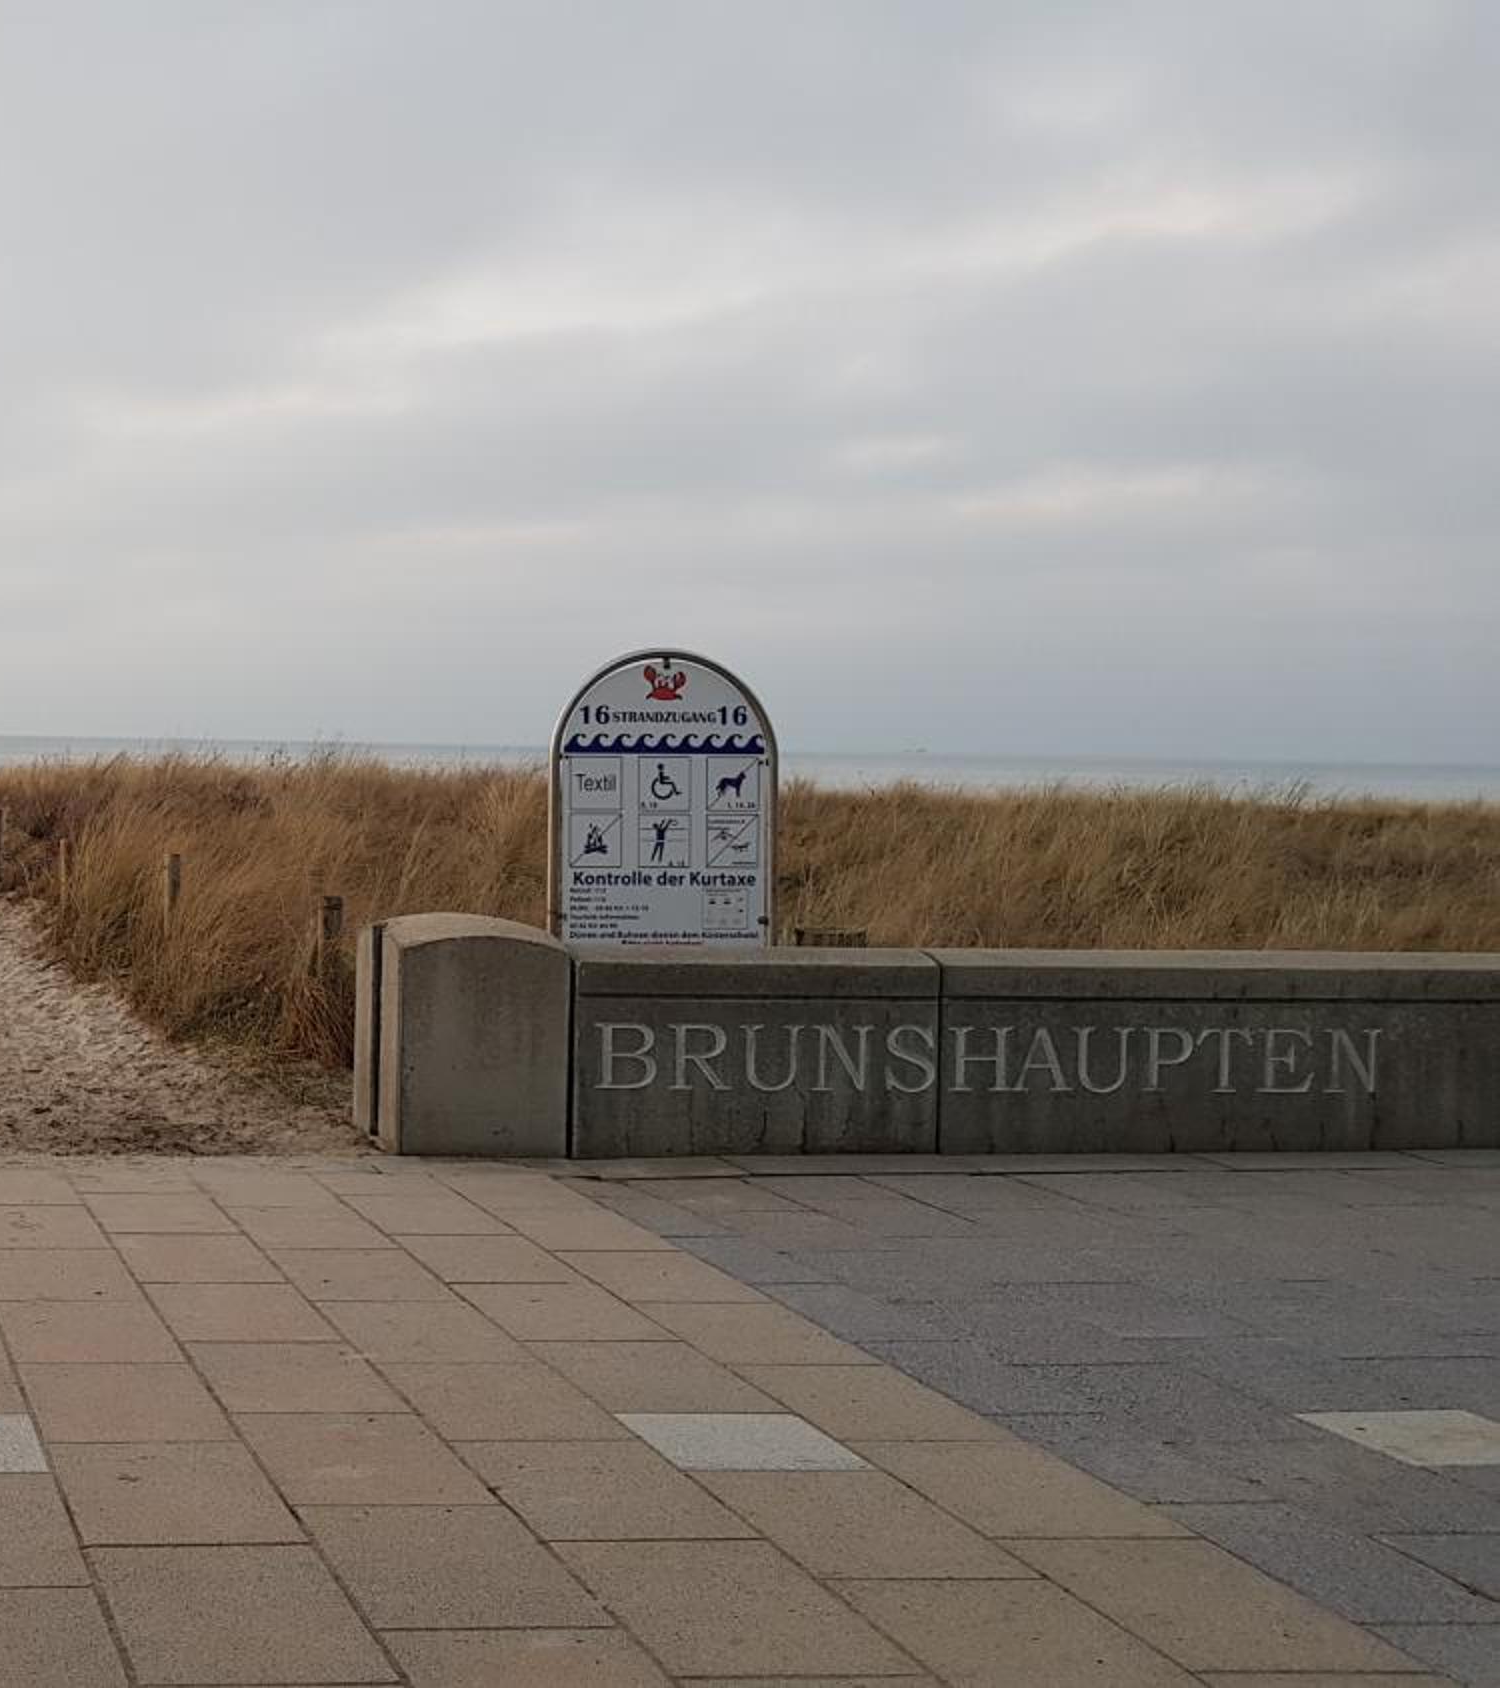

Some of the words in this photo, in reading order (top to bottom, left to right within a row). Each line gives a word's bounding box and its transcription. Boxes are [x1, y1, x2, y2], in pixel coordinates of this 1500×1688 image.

[580, 705, 611, 725] 16
[612, 711, 717, 724] STRANDZUGANG
[717, 705, 748, 726] 16
[575, 773, 617, 792] Textil
[572, 871, 653, 887] Kontrolle
[656, 871, 687, 887] der
[689, 871, 757, 887] Kurtaxe
[594, 1021, 1384, 1095] BRUNSHAUPTEN
